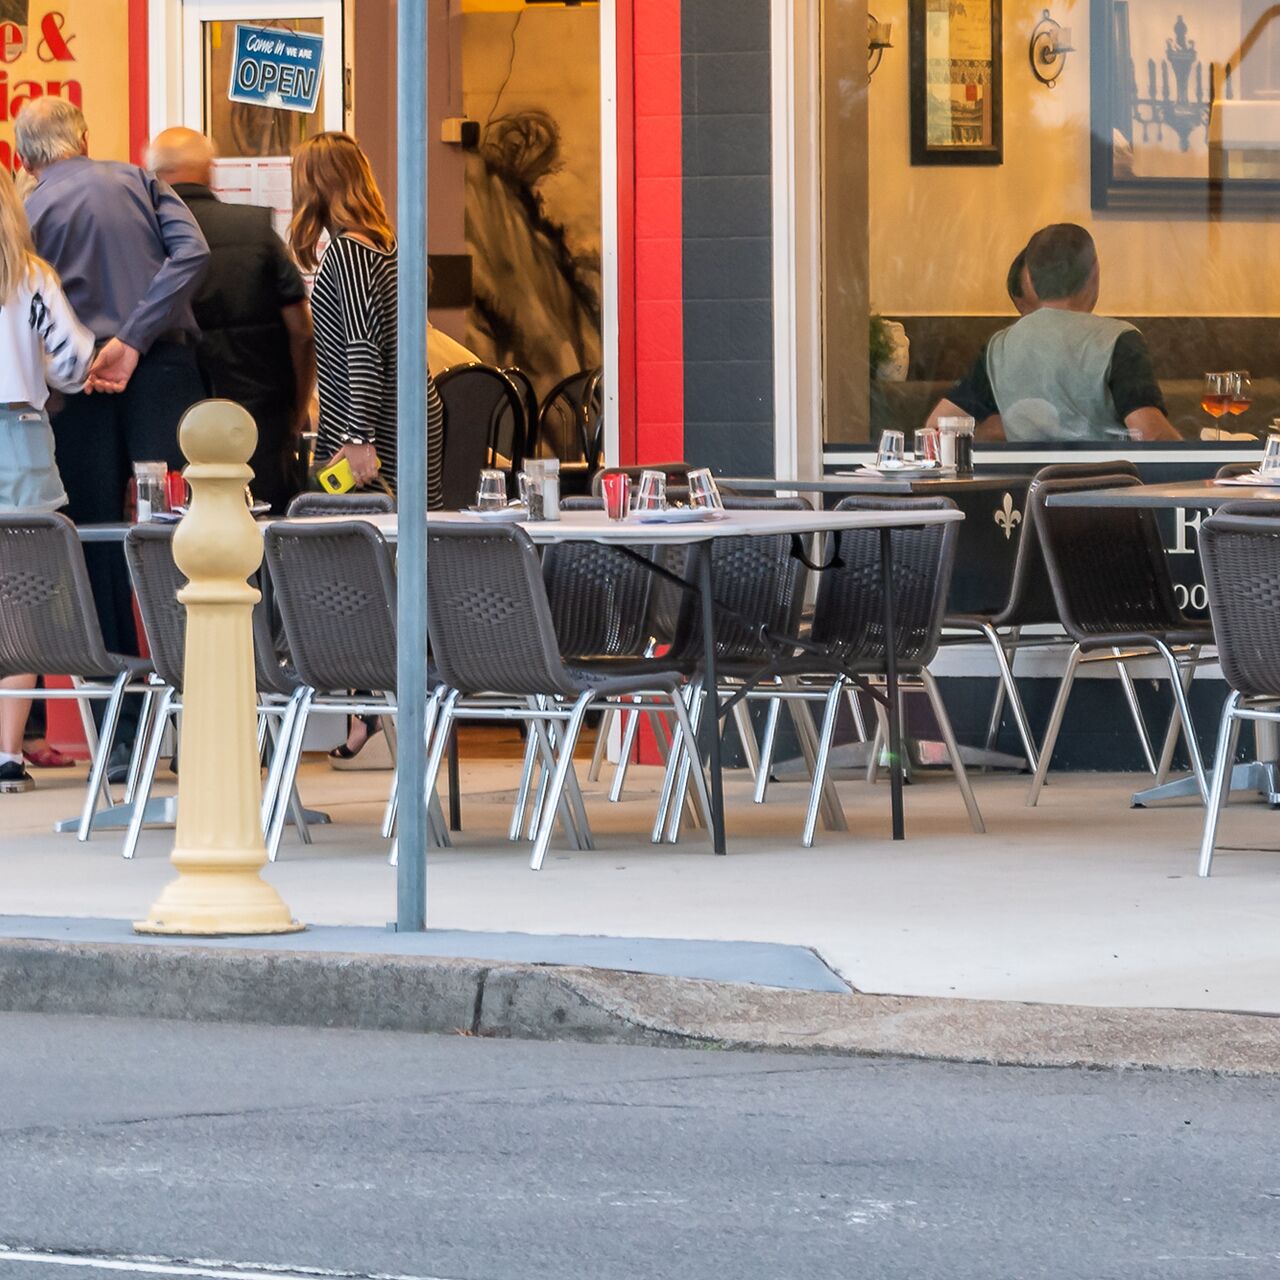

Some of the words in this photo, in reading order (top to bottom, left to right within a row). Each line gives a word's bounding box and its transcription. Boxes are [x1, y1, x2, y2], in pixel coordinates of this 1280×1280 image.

[36, 11, 77, 63] &
[246, 34, 275, 54] Come
[274, 39, 286, 55] in
[286, 46, 298, 58] WE
[299, 47, 313, 59] ARE
[240, 59, 315, 99] OPEN
